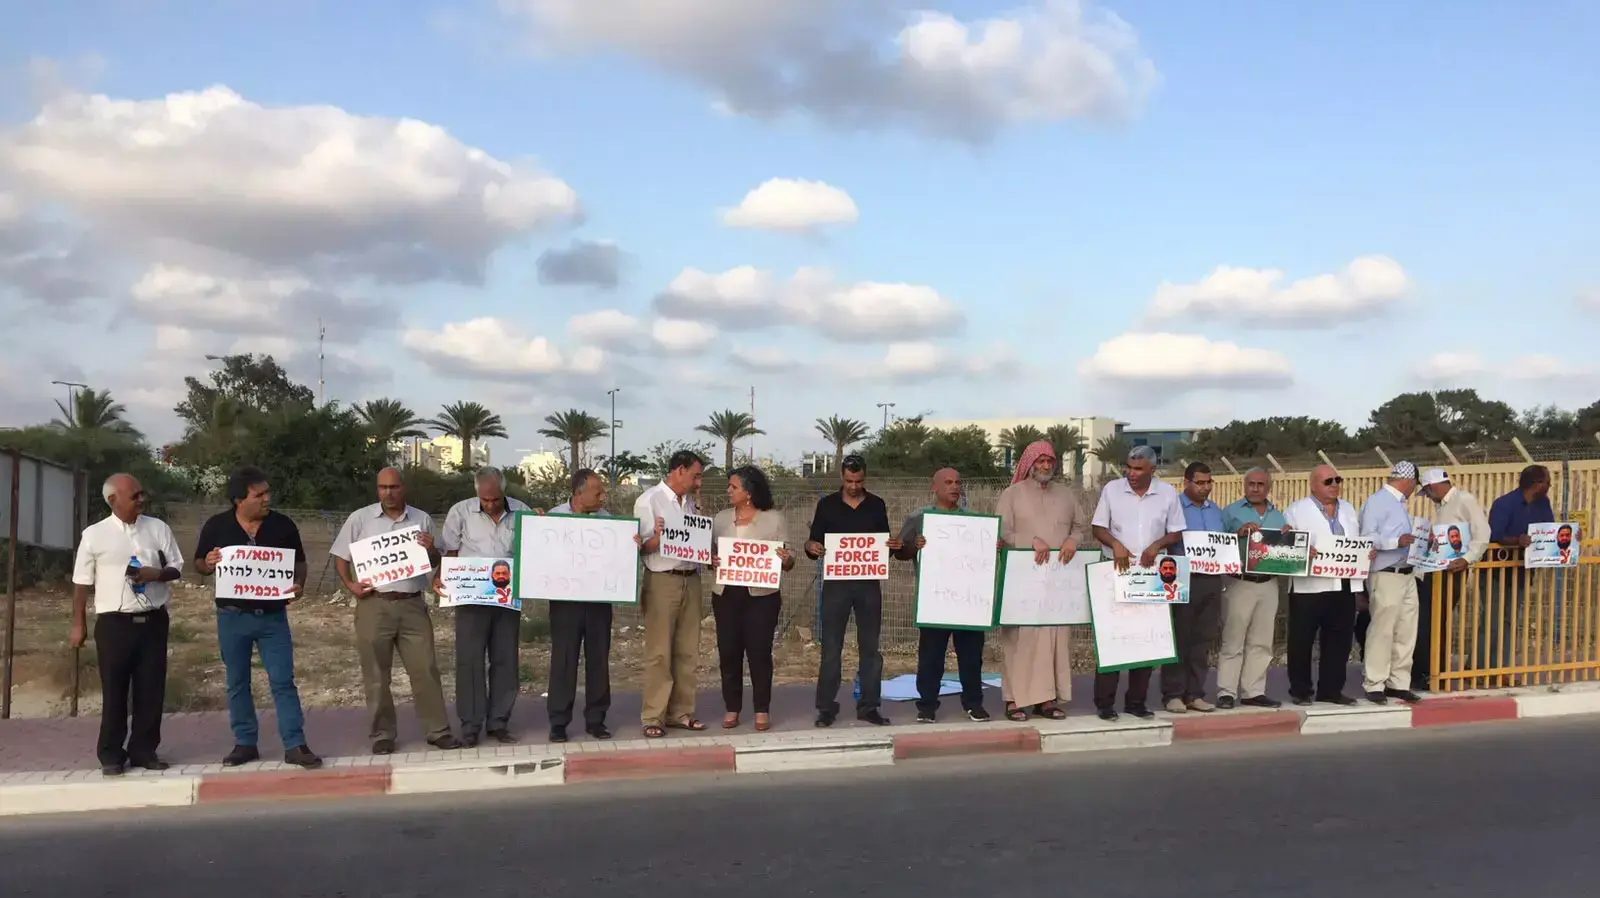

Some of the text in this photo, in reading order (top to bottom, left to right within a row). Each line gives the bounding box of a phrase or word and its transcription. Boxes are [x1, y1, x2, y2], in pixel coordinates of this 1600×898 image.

[683, 514, 712, 530] רפואה
[371, 529, 421, 551] האכלה
[660, 527, 690, 543] לריפוי
[1208, 533, 1237, 546] רפואה
[733, 541, 769, 555] STOP
[839, 536, 876, 549] STOP
[1335, 538, 1374, 549] האכלה
[230, 549, 284, 562] רופא/ה,
[663, 543, 710, 562] לא לכפייה
[835, 550, 879, 562] FORCE
[1186, 545, 1216, 558] לריפוי
[1315, 551, 1358, 563] בכפייה
[356, 550, 409, 573] בכפייה
[728, 555, 772, 569] FORCE
[1190, 560, 1239, 573] לא לכפייה
[217, 564, 294, 579] סרב/י להזין
[719, 568, 778, 584] FEEDING
[826, 564, 887, 576] FEEDING
[1313, 565, 1357, 577] עינויים
[233, 584, 280, 597] בכפייה
